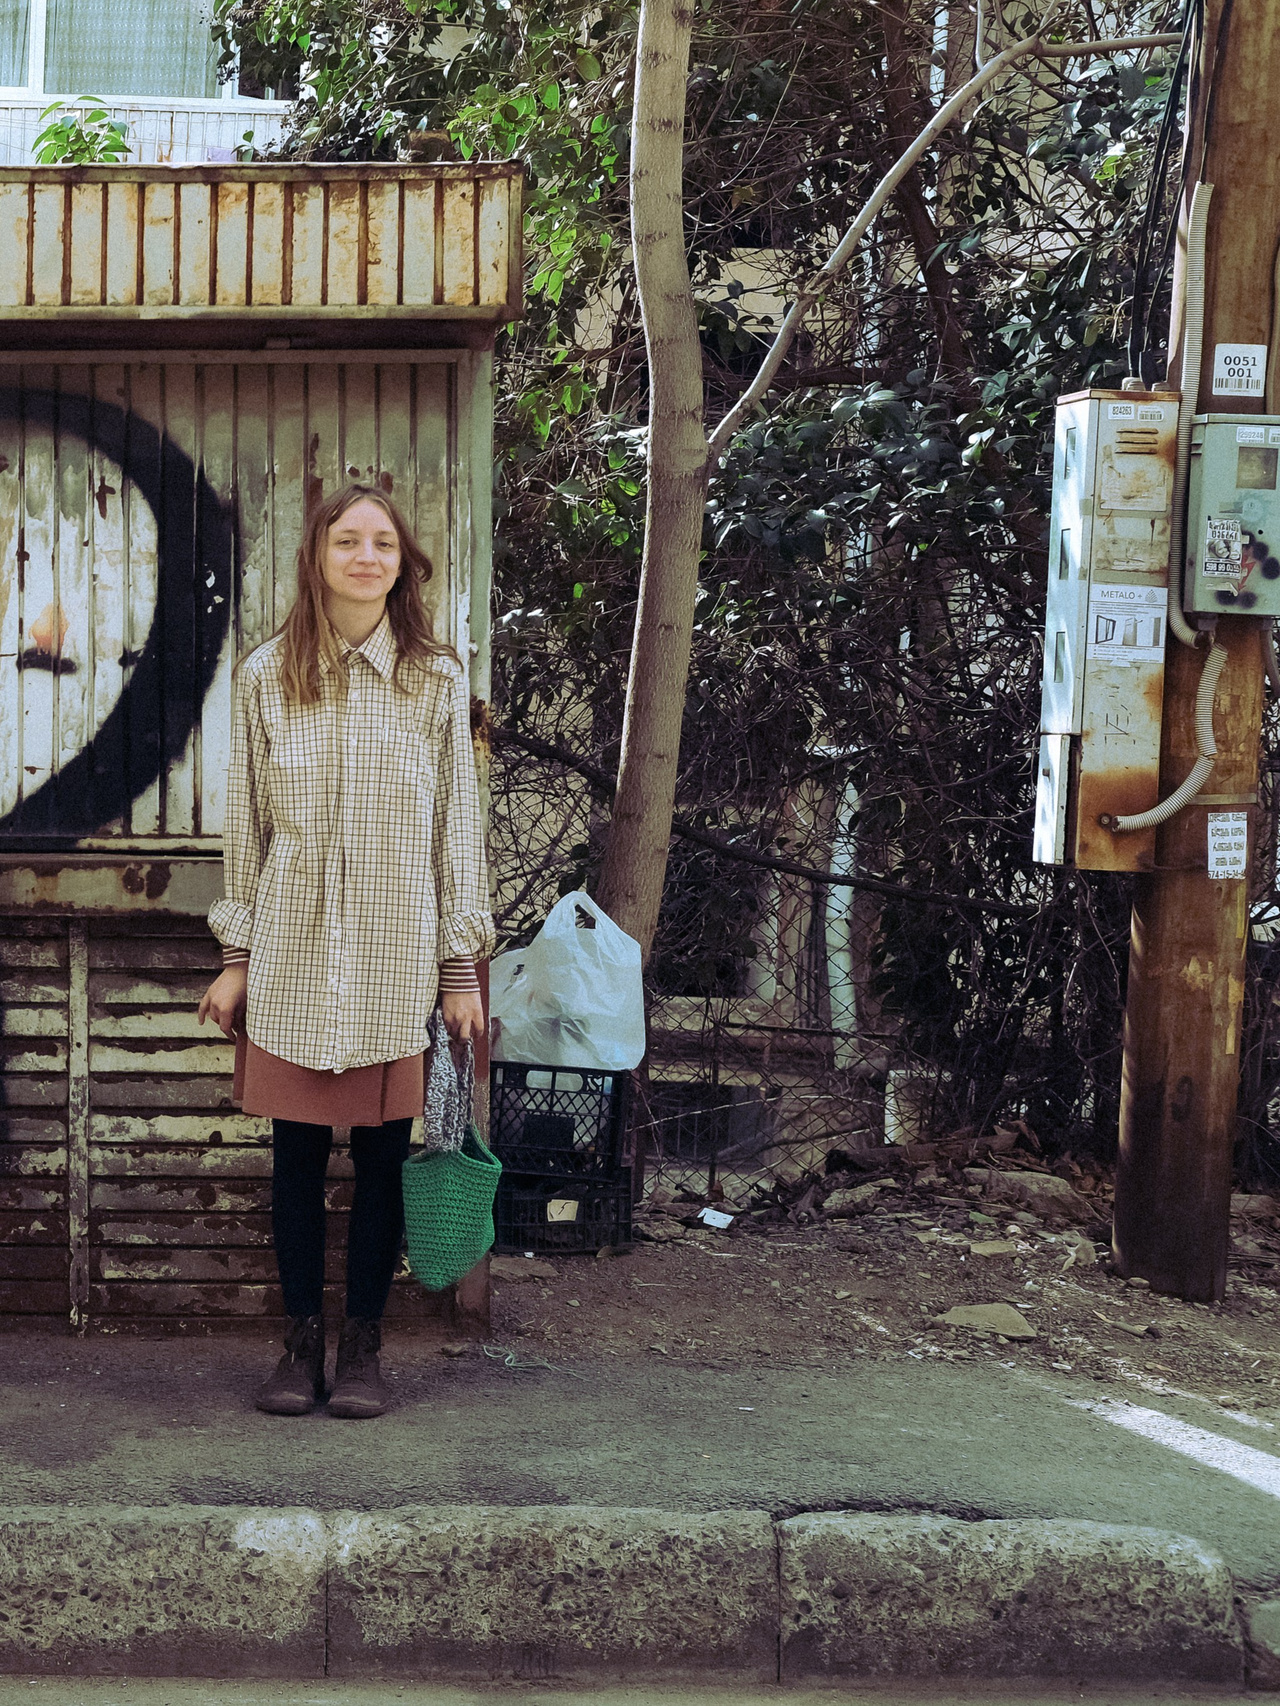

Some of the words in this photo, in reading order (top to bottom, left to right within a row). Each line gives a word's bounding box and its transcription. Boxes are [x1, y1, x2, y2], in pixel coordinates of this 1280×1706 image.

[1224, 355, 1257, 367] 0051
[1227, 367, 1252, 378] 001
[1100, 590, 1135, 600] METALO
